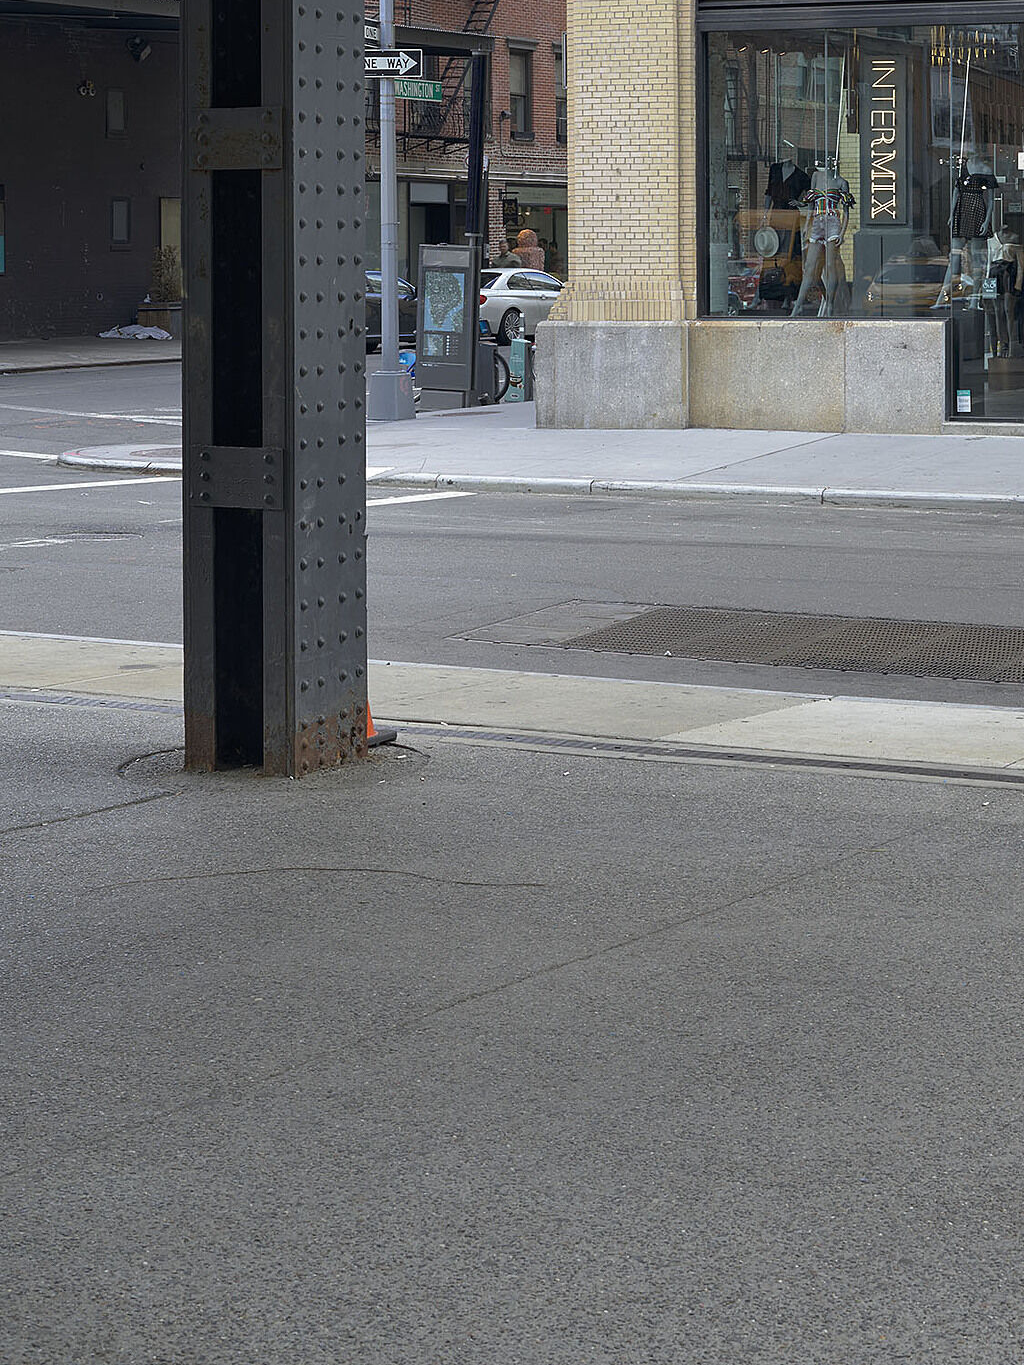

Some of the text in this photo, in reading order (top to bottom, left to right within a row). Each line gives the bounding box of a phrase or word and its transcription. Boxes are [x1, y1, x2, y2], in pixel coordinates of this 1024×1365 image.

[366, 27, 377, 38] ONE
[364, 58, 410, 68] NE WAY
[394, 81, 433, 98] WASHINGTON
[870, 60, 896, 219] INTERMIX
